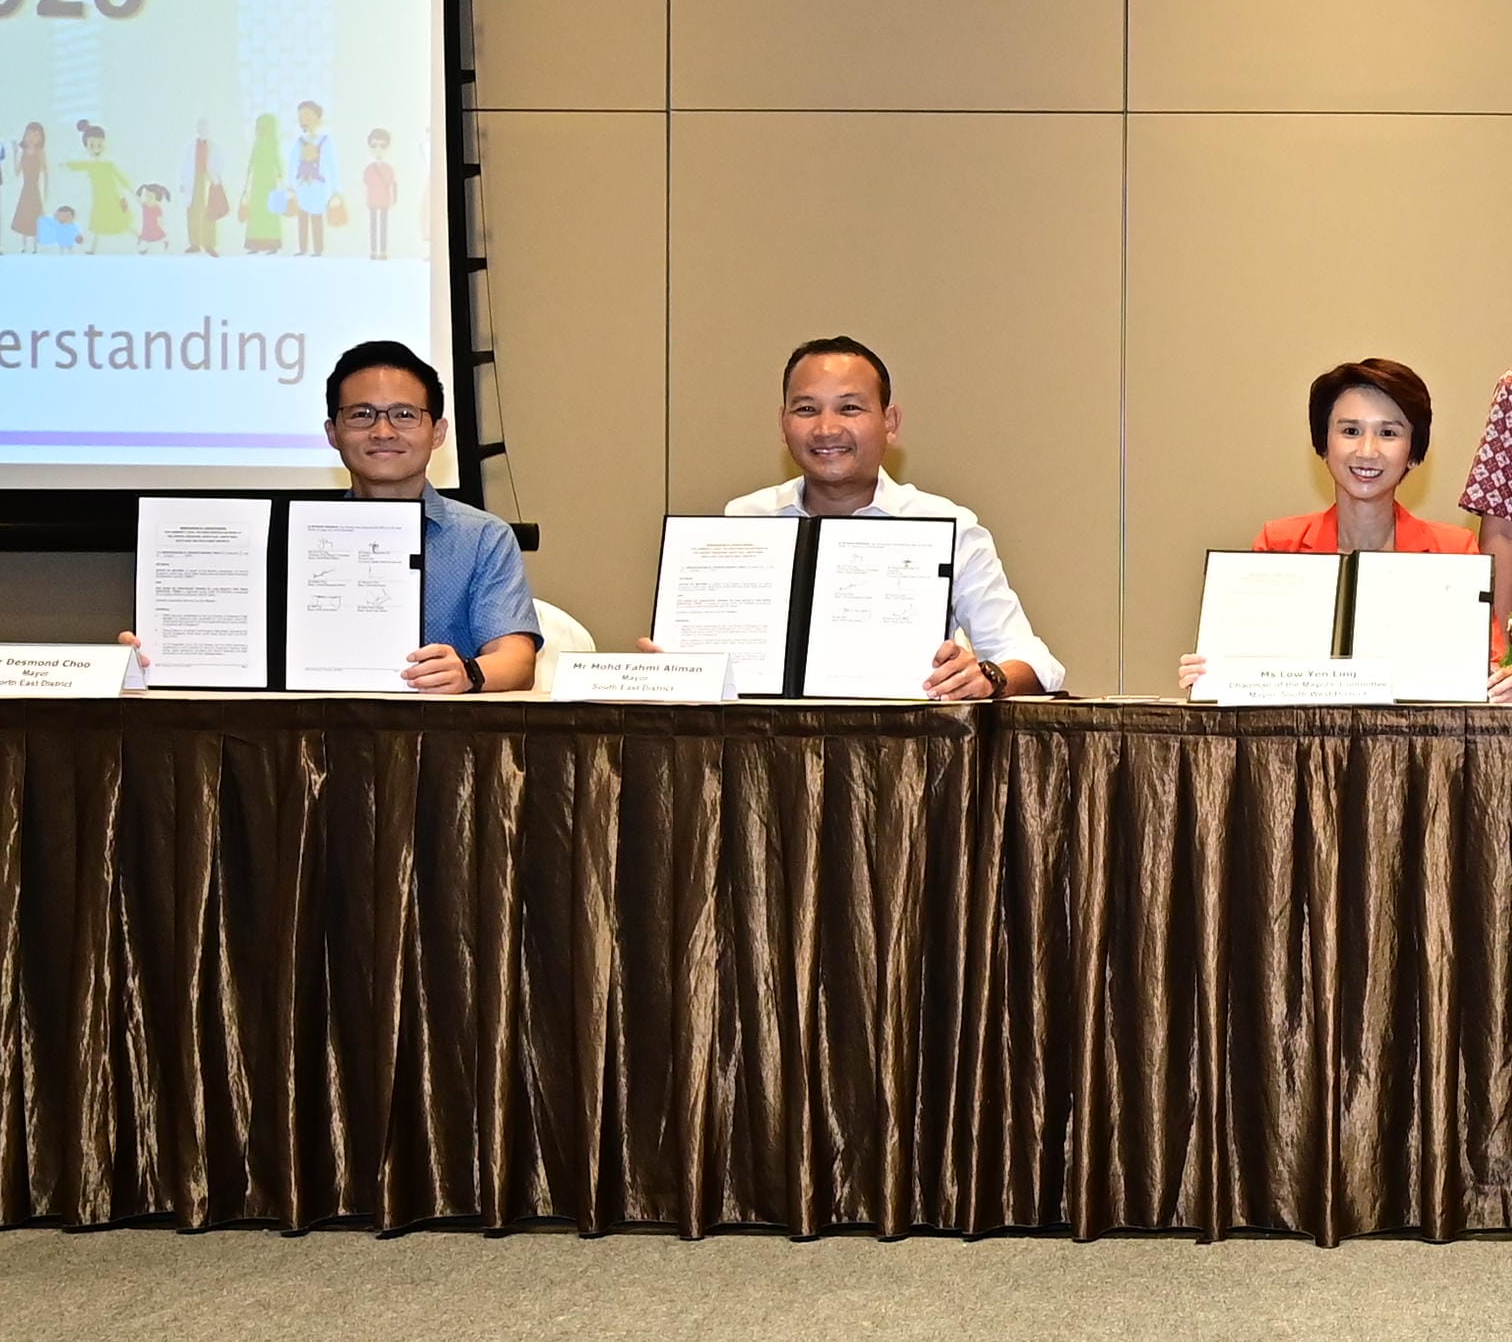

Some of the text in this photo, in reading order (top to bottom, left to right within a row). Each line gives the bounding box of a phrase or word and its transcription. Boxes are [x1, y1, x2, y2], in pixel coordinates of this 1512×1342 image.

[6, 658, 59, 668] Desmond
[62, 659, 91, 669] Choo
[573, 662, 703, 673] Mr Mohd Fahmi Aliman
[22, 669, 48, 678] Mayor
